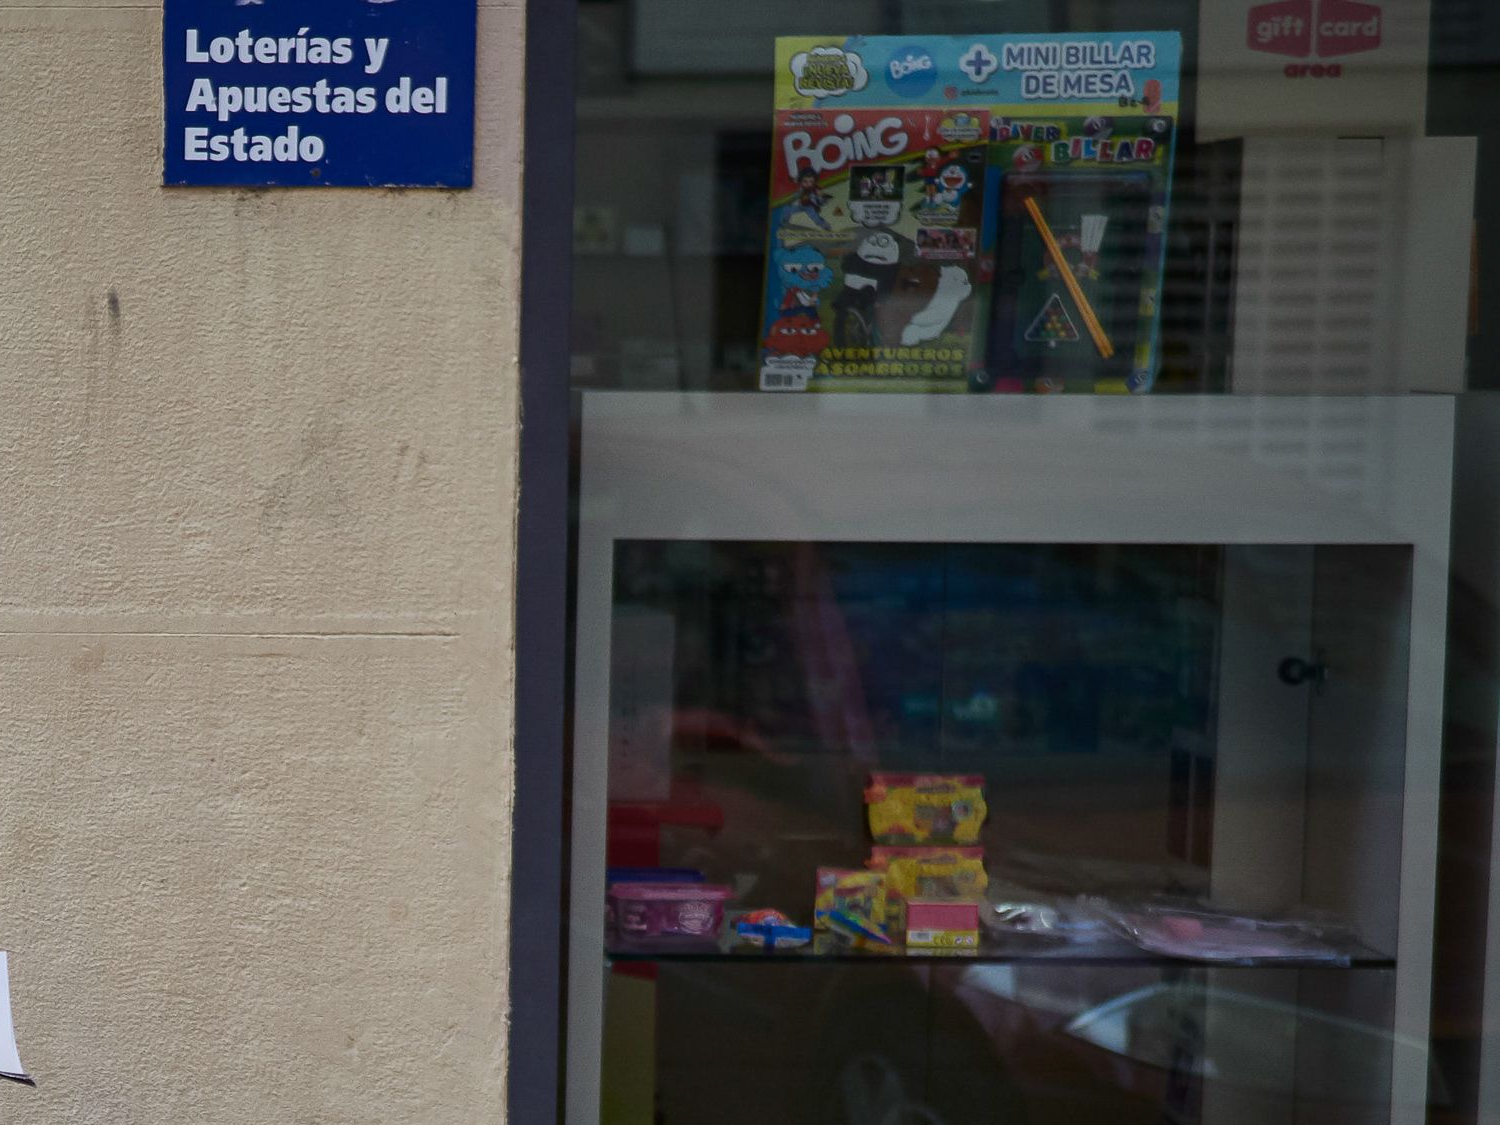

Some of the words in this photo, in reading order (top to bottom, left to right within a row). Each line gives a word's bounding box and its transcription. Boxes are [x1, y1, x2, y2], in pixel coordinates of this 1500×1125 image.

[1256, 14, 1304, 43] gift
[1319, 15, 1378, 37] card
[185, 27, 354, 64] Loterías
[363, 37, 389, 74] y
[1005, 44, 1057, 67] MINI
[1064, 43, 1152, 66] BILLAR
[1024, 73, 1056, 95] DE
[1062, 72, 1132, 94] MESA
[1284, 64, 1341, 78] area
[185, 77, 377, 122] Apuestas
[385, 77, 447, 114] del
[184, 126, 325, 162] Estado
[1050, 135, 1155, 164] BILLAR
